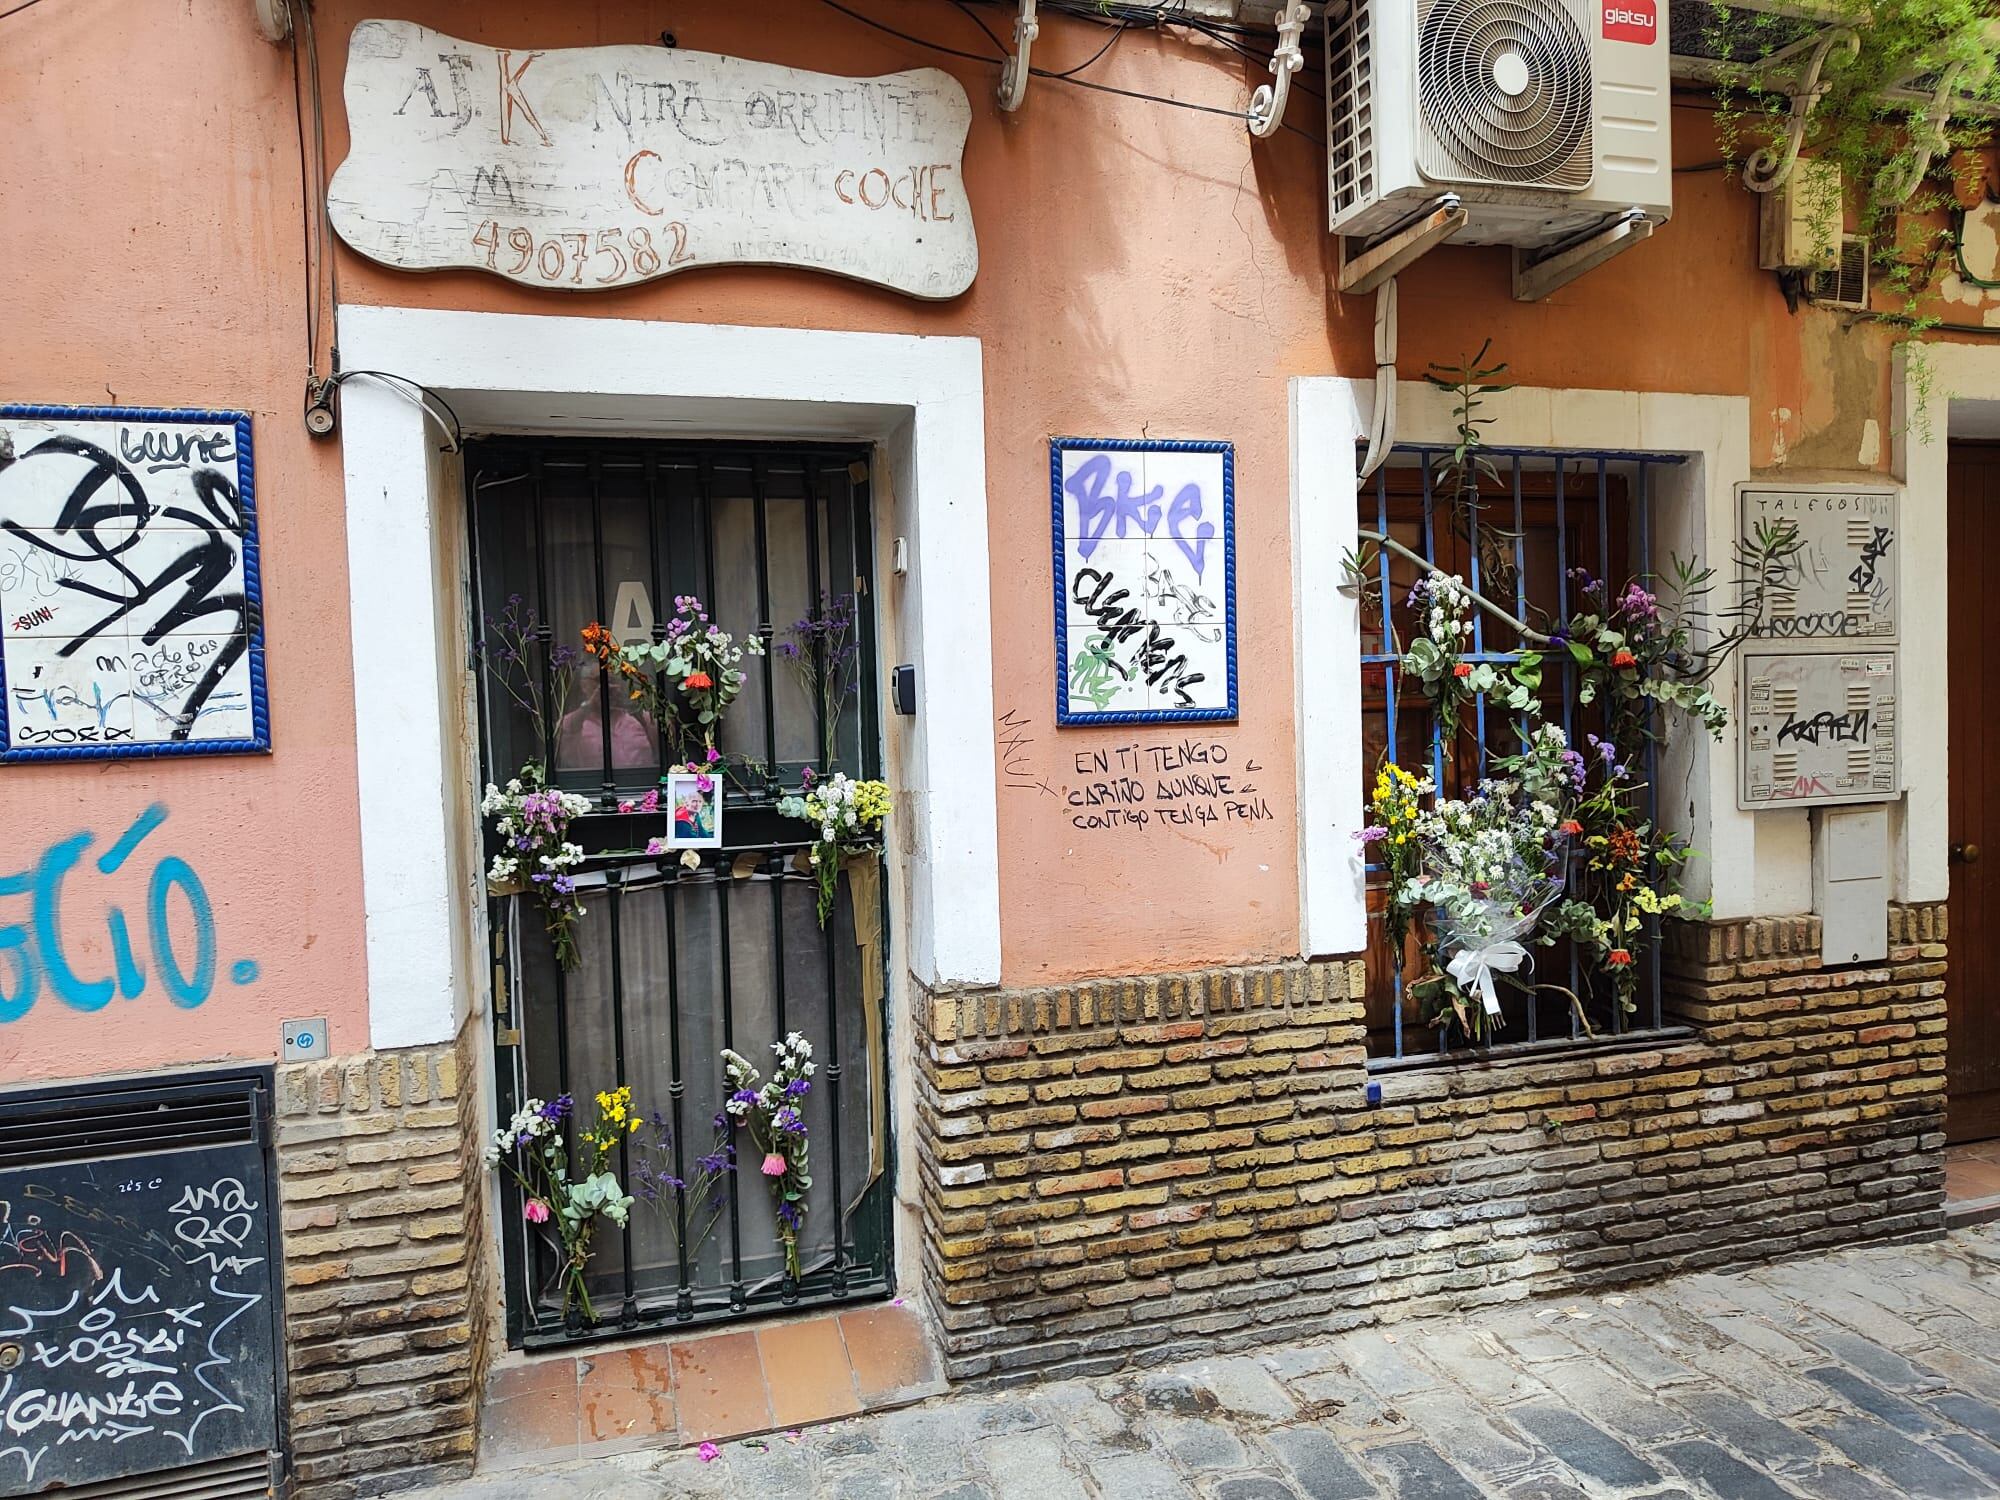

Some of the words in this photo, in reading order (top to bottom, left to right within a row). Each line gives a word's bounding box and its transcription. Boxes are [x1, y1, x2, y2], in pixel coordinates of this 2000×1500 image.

[1605, 8, 1654, 27] giatsu
[835, 164, 955, 224] COCHE
[1756, 497, 1860, 511] TALEGOS
[611, 581, 655, 645] A
[1075, 749, 1108, 774] EN
[1144, 739, 1228, 773] TENGO
[1067, 777, 1145, 806] CARIÑO
[1157, 773, 1234, 800] AUNQUE
[1073, 808, 1149, 831] CONTIGO
[1154, 804, 1219, 828] TENGA
[1224, 799, 1274, 821] PENA
